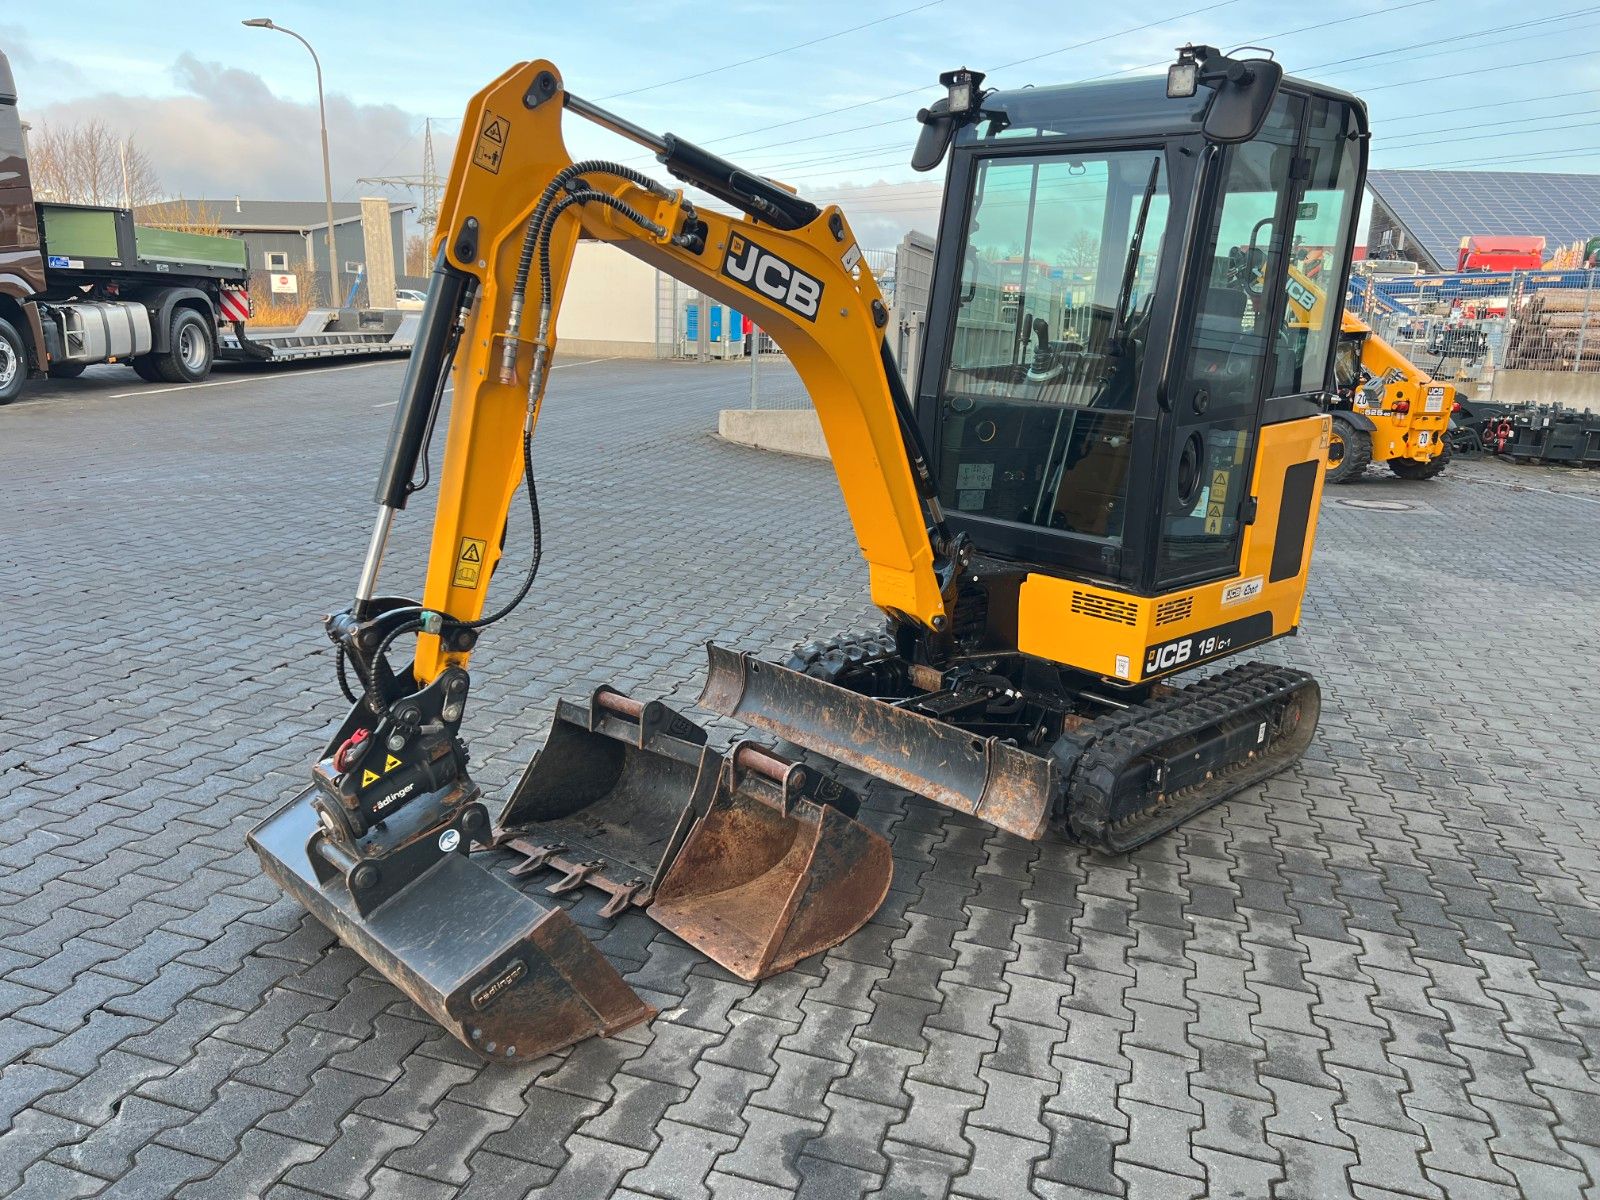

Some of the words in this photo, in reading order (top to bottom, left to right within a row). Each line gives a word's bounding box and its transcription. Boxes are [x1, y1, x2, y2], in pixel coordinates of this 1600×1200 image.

[727, 245, 820, 317] JCB
[1428, 387, 1444, 396] JCB
[1357, 394, 1367, 405] 20
[1419, 433, 1429, 444] 20
[1226, 588, 1242, 600] JCB
[1146, 639, 1193, 673] JCB
[372, 782, 415, 813] rädlinger
